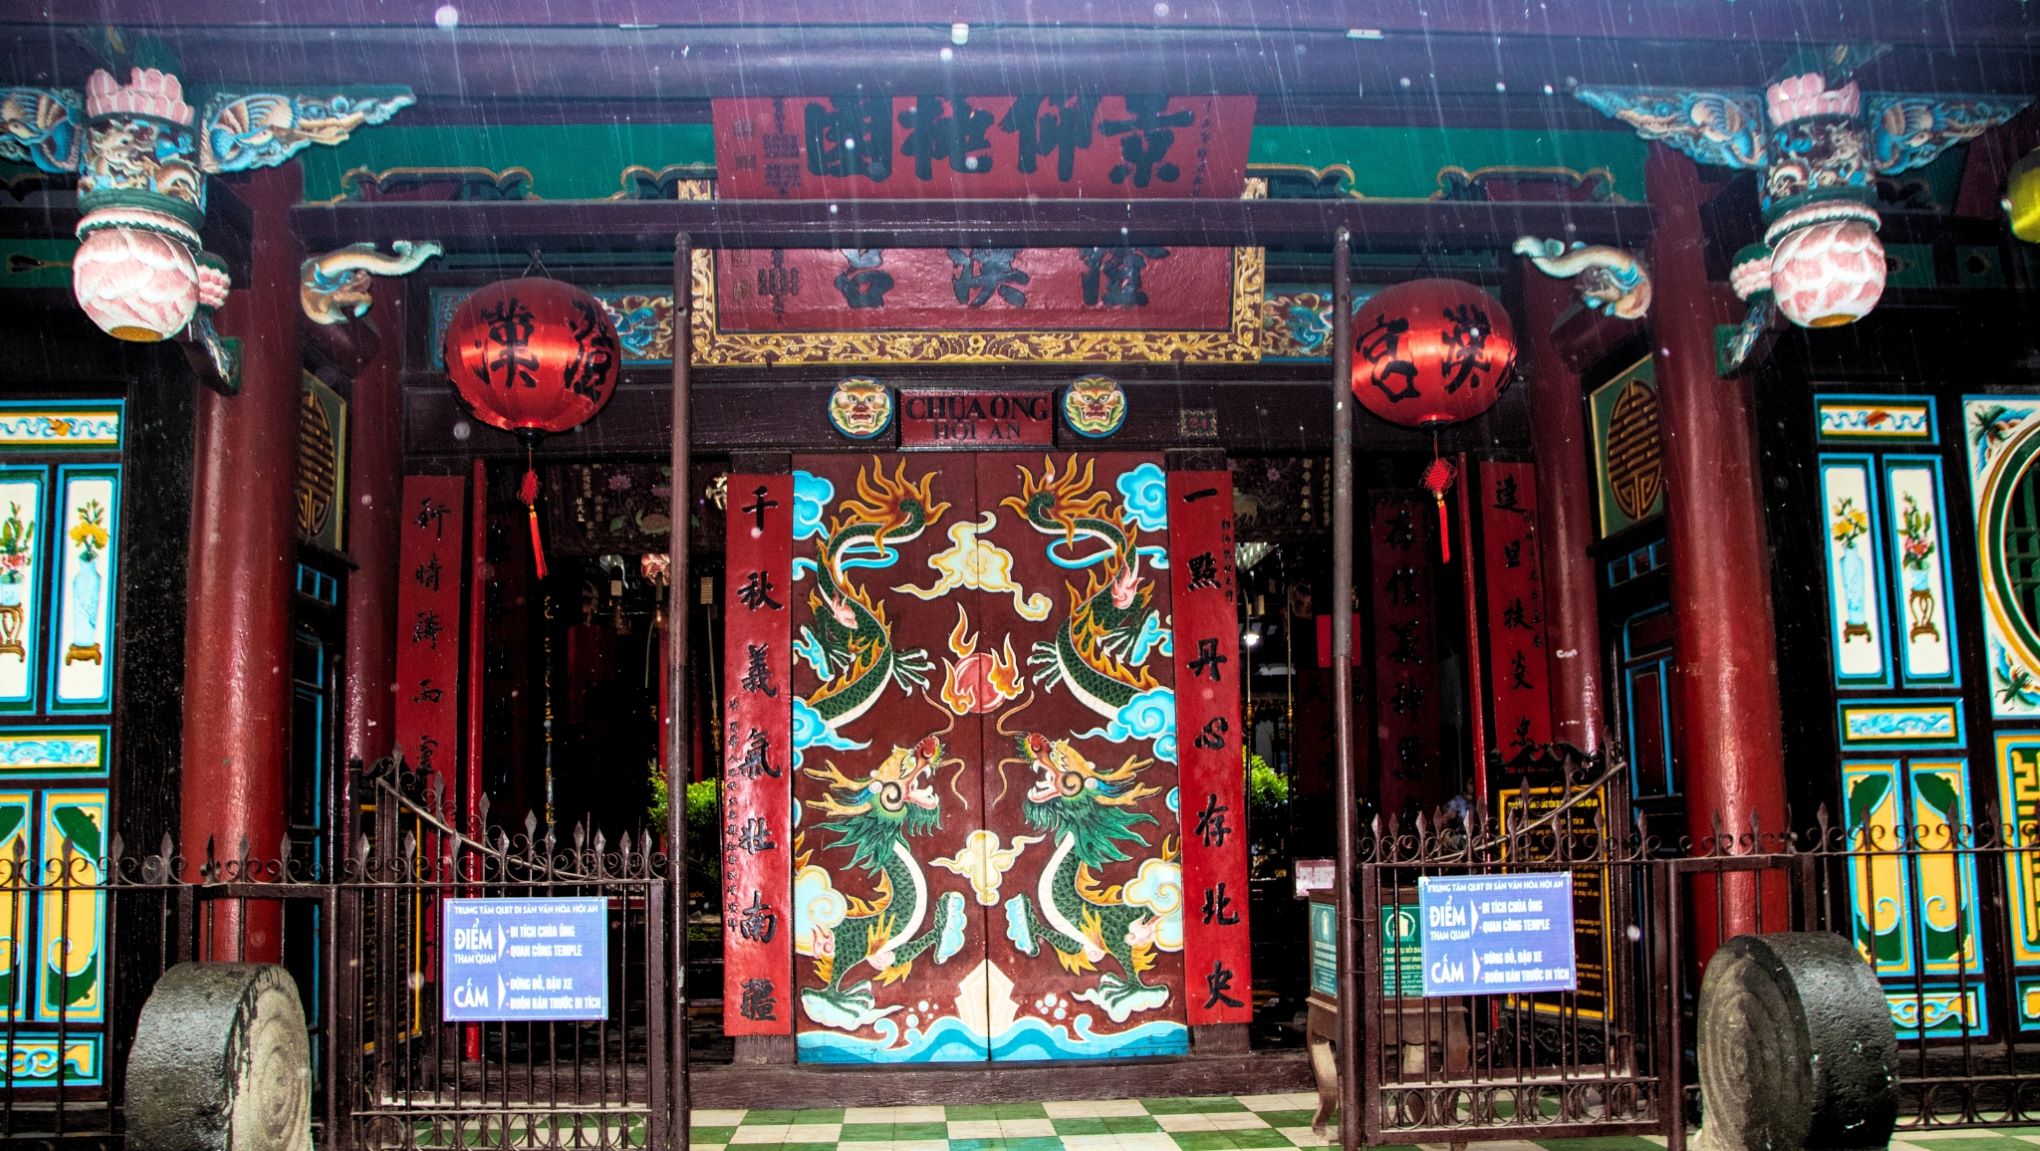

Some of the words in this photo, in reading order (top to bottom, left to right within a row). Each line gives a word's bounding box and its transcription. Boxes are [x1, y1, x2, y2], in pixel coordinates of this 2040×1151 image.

[1429, 895, 1466, 928] ĐIỂM
[1523, 918, 1550, 931] TEMPLE
[453, 918, 493, 950] ĐIỂM
[1430, 931, 1450, 940] THAM
[1450, 930, 1470, 941] QUAN
[553, 944, 583, 957] TEMPLE
[1533, 951, 1543, 962] XE
[454, 953, 476, 964] THAM
[476, 953, 497, 965] QUAN
[1431, 953, 1465, 983] CẤM
[562, 977, 573, 990] XE
[453, 977, 489, 1008] CẤM
